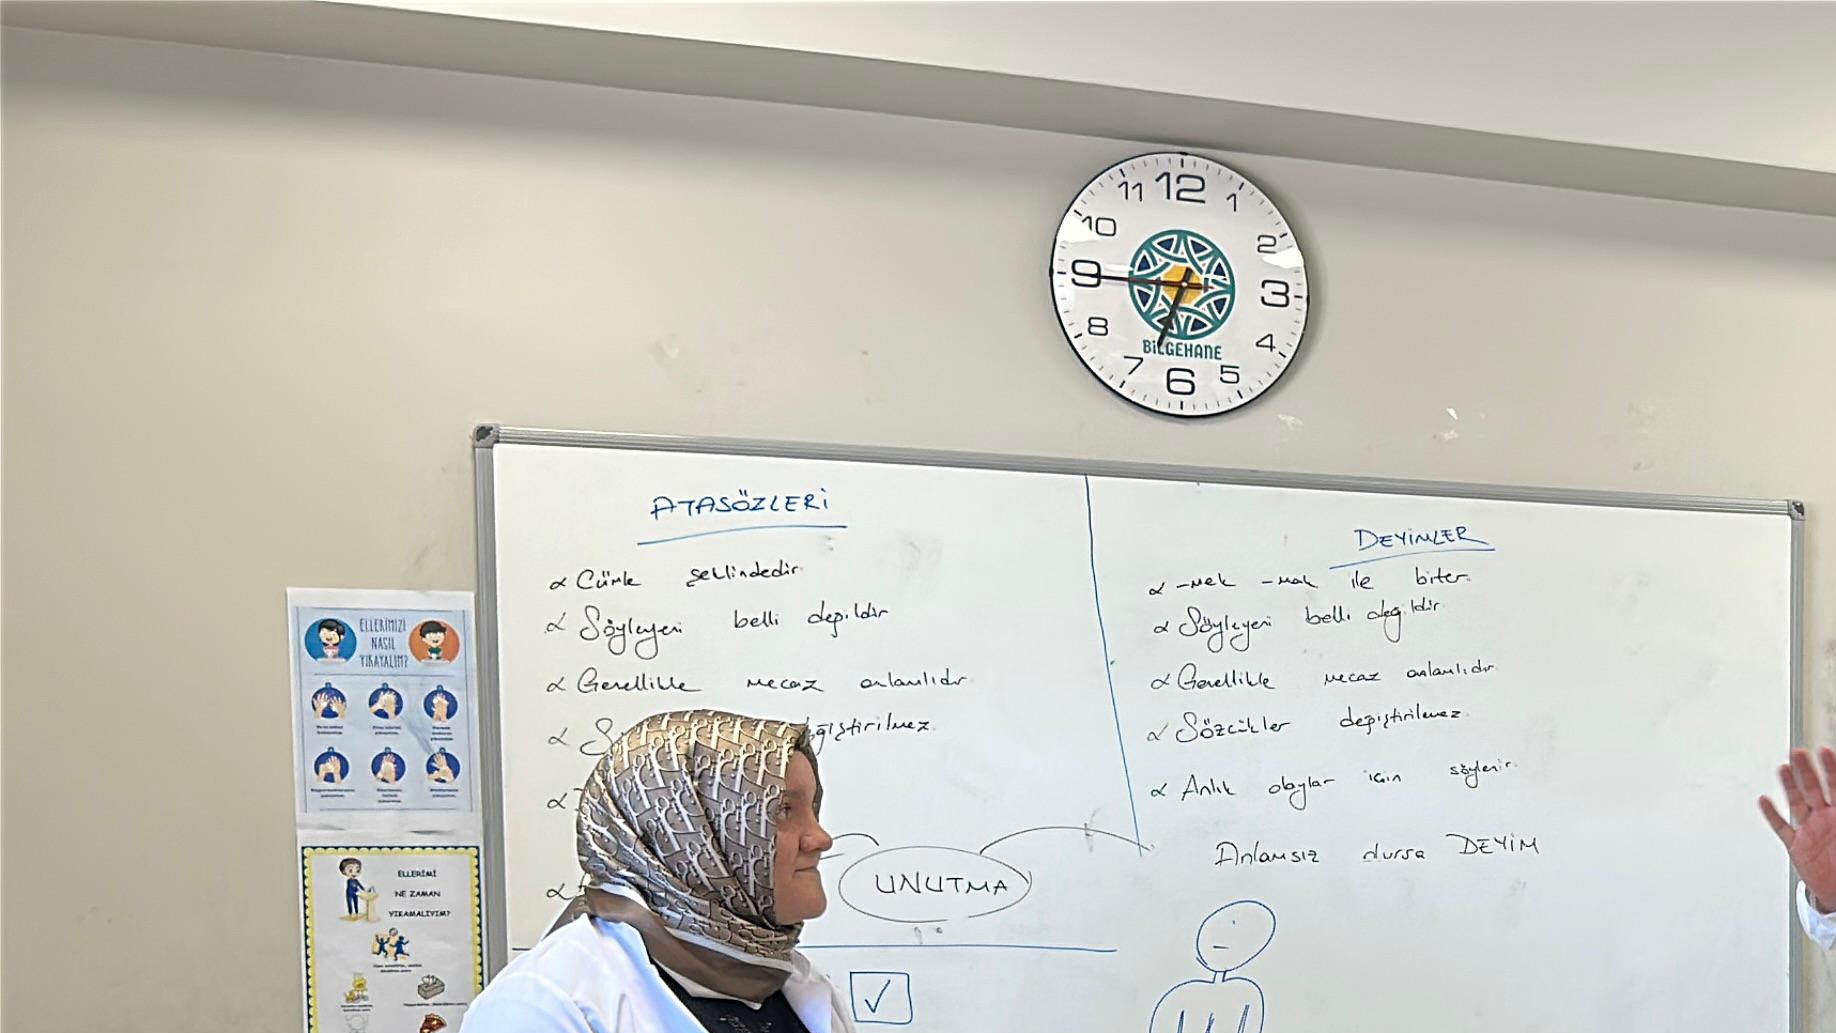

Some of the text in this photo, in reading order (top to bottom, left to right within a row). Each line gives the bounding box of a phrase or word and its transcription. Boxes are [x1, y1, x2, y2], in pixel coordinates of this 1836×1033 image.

[1118, 182, 1143, 201] 11
[1155, 172, 1206, 203] 12
[1226, 193, 1237, 212] 1
[1082, 215, 1117, 236] 10
[1257, 235, 1277, 254] 2
[1071, 259, 1101, 288] 9
[1260, 280, 1290, 308] 3
[1087, 317, 1109, 336] 8
[1255, 333, 1276, 352] 4
[1123, 355, 1144, 375] 7
[1220, 365, 1240, 384] 5
[1166, 367, 1196, 395] 6
[650, 488, 829, 520] ATASÖZLERİ
[1354, 526, 1490, 551] DEYİMLER
[734, 609, 780, 629] belli
[1305, 605, 1350, 626] belli
[1363, 843, 1426, 862] dursa
[875, 872, 1009, 896] UNUTMA
